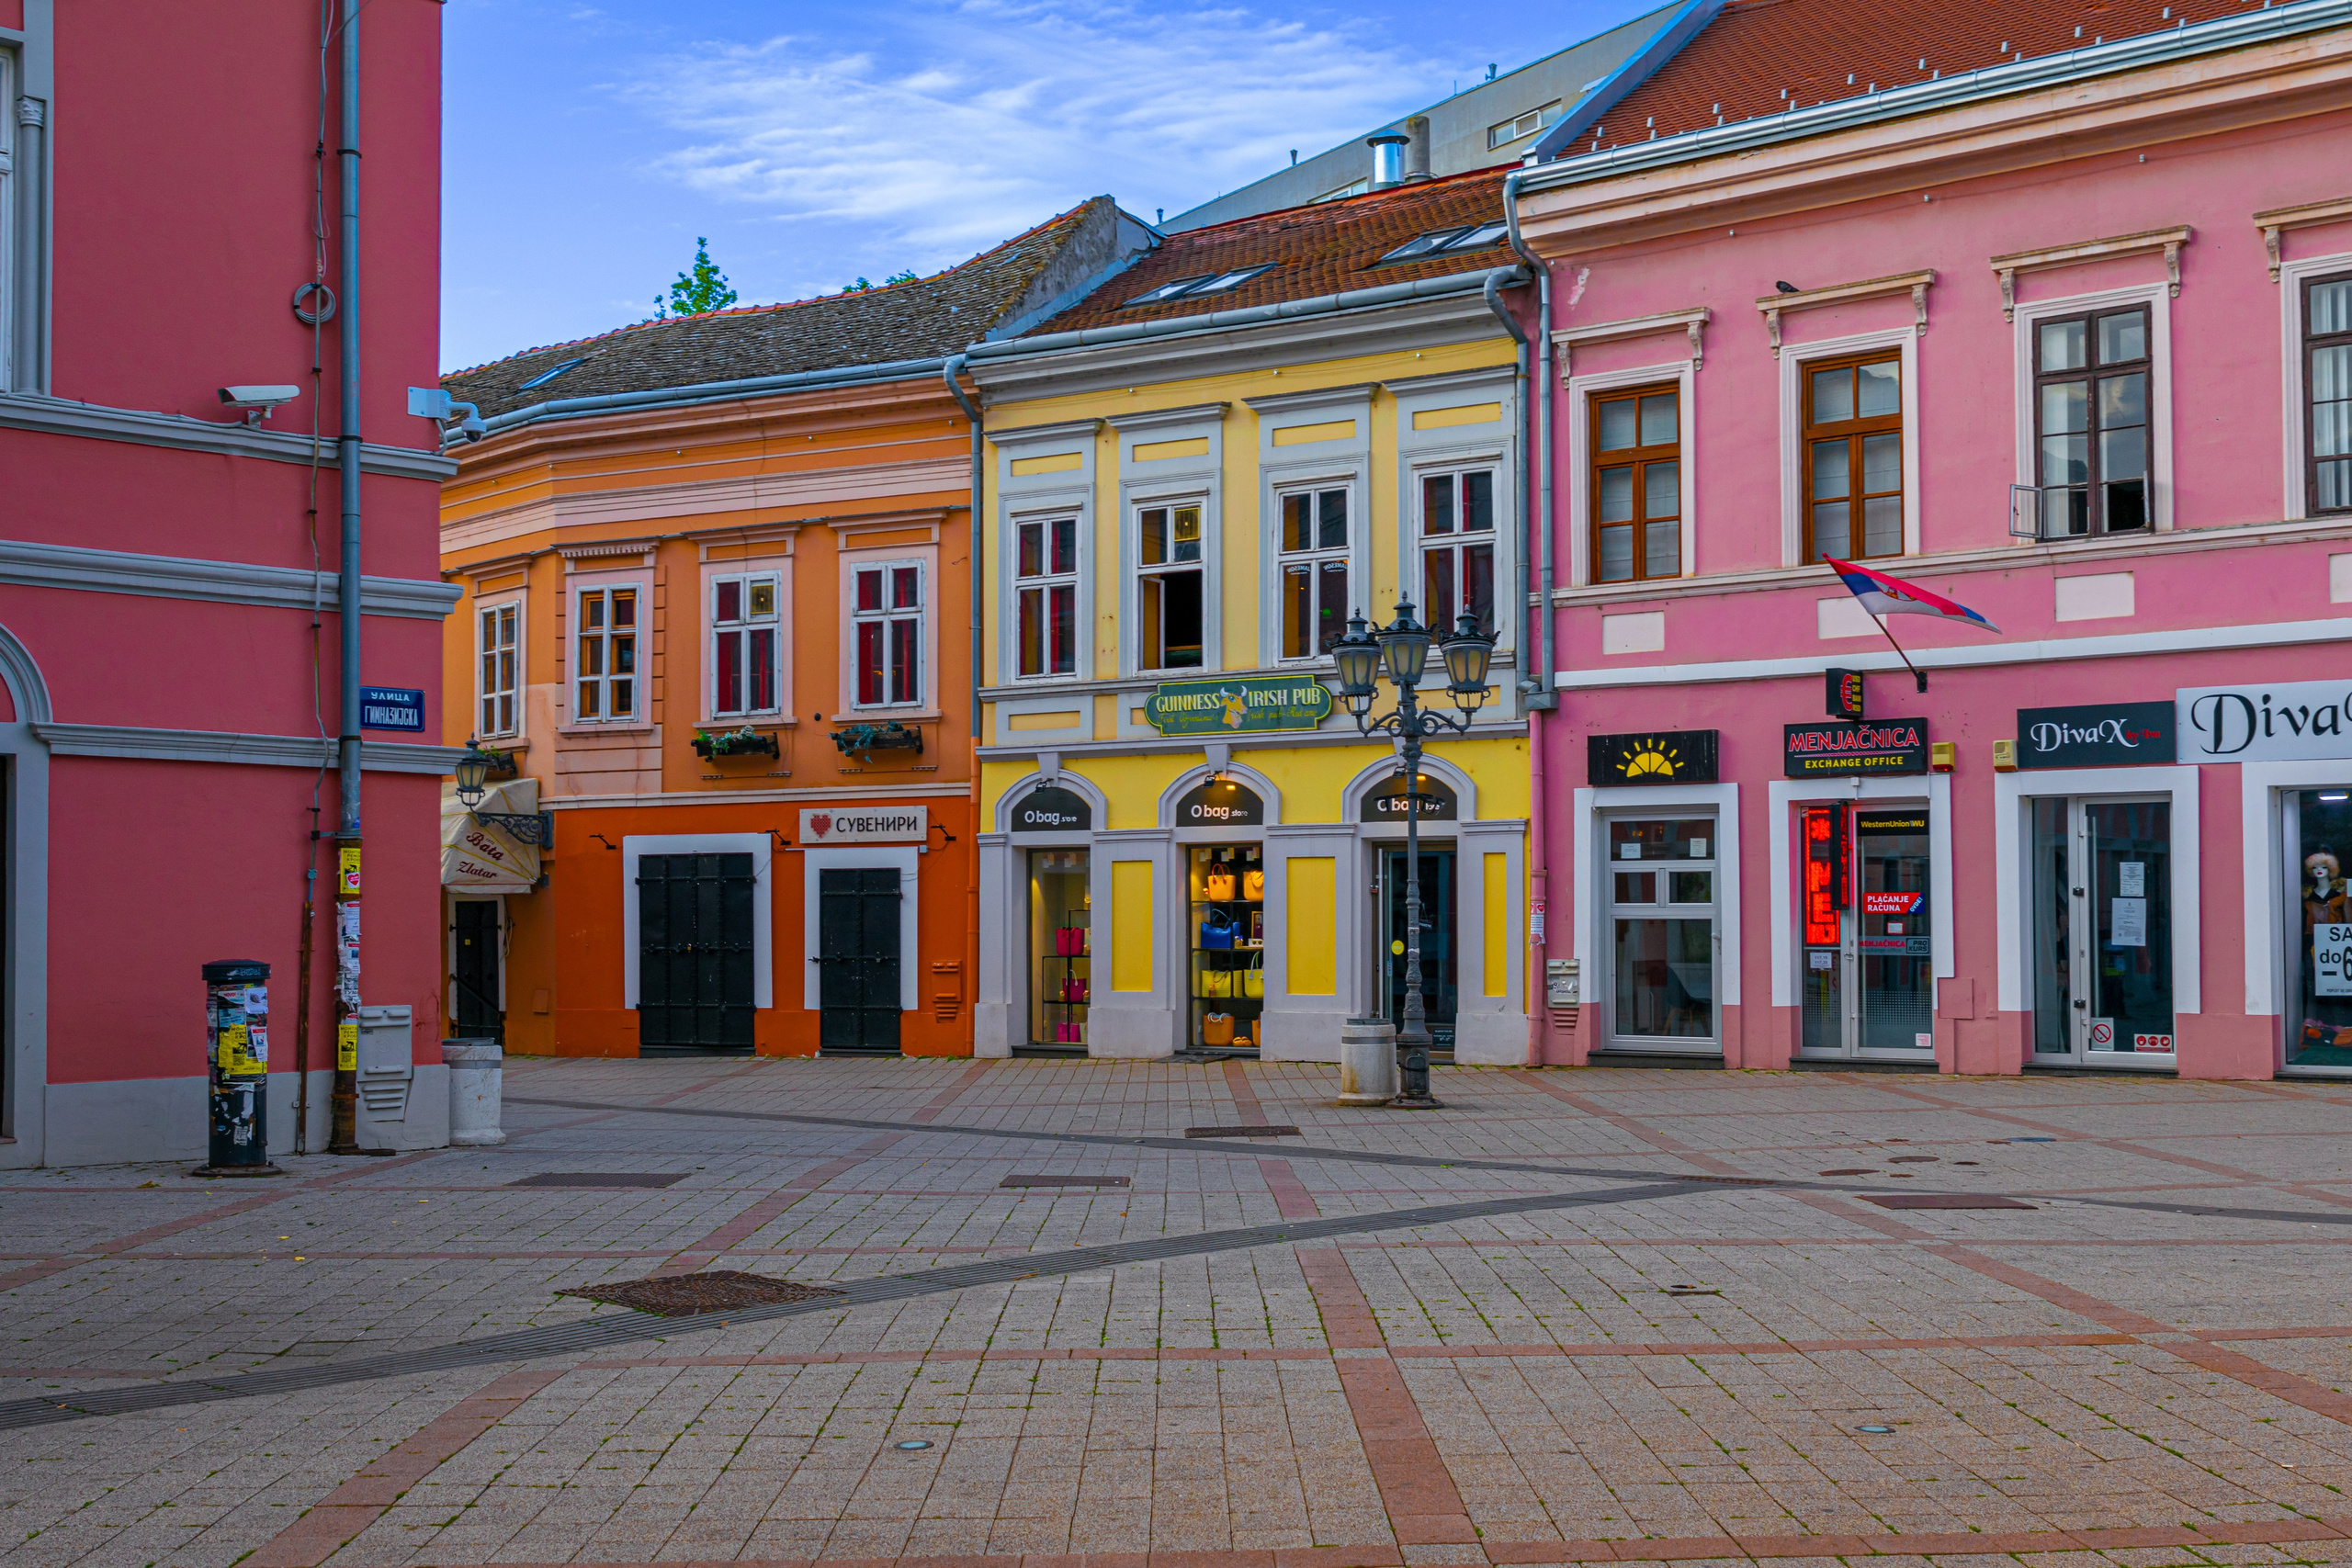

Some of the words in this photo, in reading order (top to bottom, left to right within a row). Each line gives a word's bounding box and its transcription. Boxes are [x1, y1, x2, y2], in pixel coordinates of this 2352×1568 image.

[370, 692, 410, 701] УЛИЦА
[1156, 693, 1220, 713] GUINNESS
[1248, 689, 1287, 707] IRISH
[1293, 687, 1320, 705] PUB
[365, 705, 418, 726] ГИМНАЗИЈСКА
[2191, 694, 2352, 754] Diva
[1789, 724, 1919, 752] MENJAČNICA
[2030, 719, 2139, 752] DivaX
[1804, 758, 1861, 769] EXCHANGE
[1864, 756, 1904, 767] OFFICE
[836, 816, 917, 832] СУВЕНИРИ
[466, 832, 503, 861] Bata
[457, 861, 498, 878] Zlatar
[1867, 893, 1909, 903] PLAĆANJE
[1867, 902, 1901, 912] RAČUNA
[1859, 938, 1906, 948] MENJAČNICA
[2320, 949, 2341, 964] do
